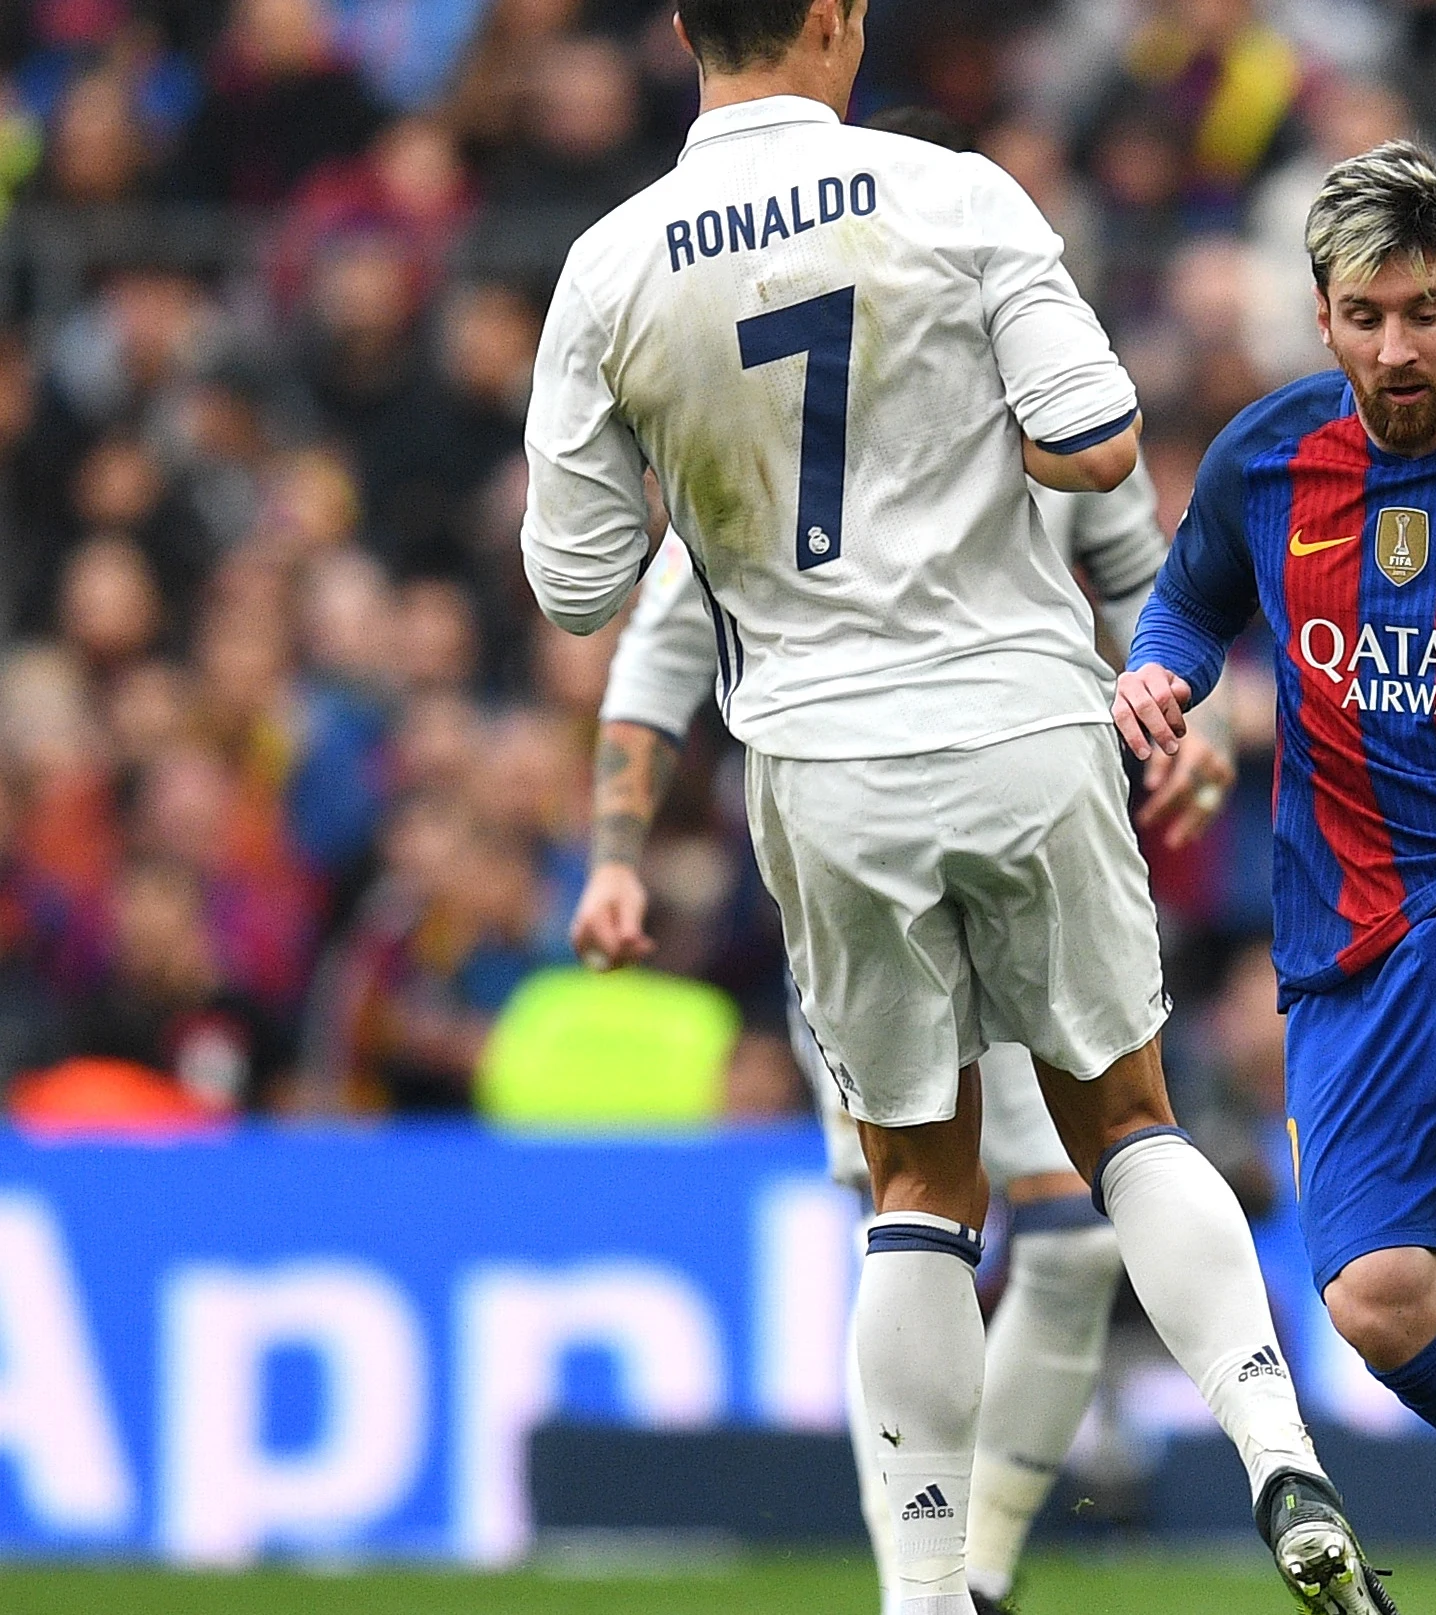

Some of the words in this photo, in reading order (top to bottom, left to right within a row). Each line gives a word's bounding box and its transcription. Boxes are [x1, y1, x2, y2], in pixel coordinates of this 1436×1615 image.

[665, 171, 877, 273] RONALDO
[735, 284, 856, 572] 7
[1388, 556, 1412, 567] FIFA
[1238, 1363, 1287, 1383] adidas
[901, 1507, 955, 1521] adidas
